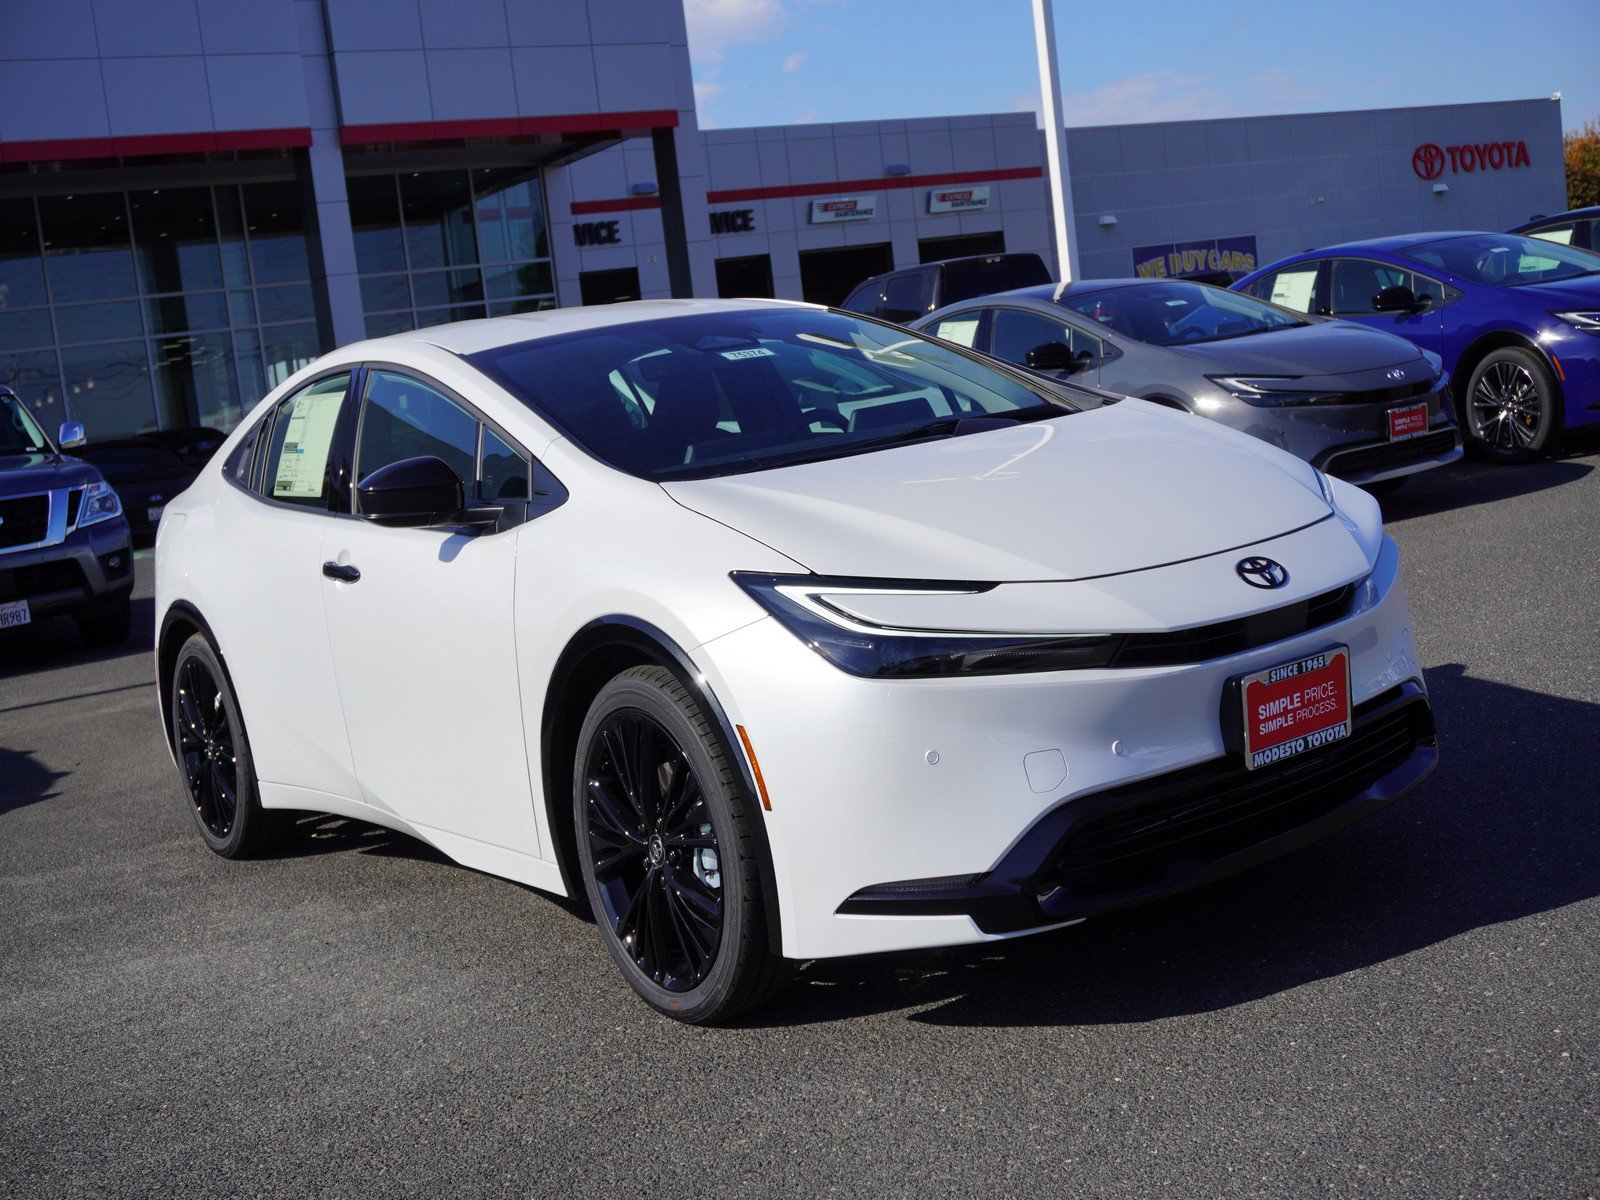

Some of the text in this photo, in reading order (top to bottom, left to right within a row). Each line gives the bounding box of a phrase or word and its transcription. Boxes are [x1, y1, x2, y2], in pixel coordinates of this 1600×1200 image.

[1446, 141, 1531, 173] TOYOTA
[1136, 256, 1167, 278] WE
[1208, 248, 1255, 274] CARS
[730, 349, 766, 359] 75374
[1270, 656, 1325, 682] SINCE 1965
[1258, 681, 1338, 720] SIMPLE PRICE.
[1259, 698, 1338, 735] SIMPLE PROCESS.
[1254, 724, 1347, 767] MODESTO TOYOTA
